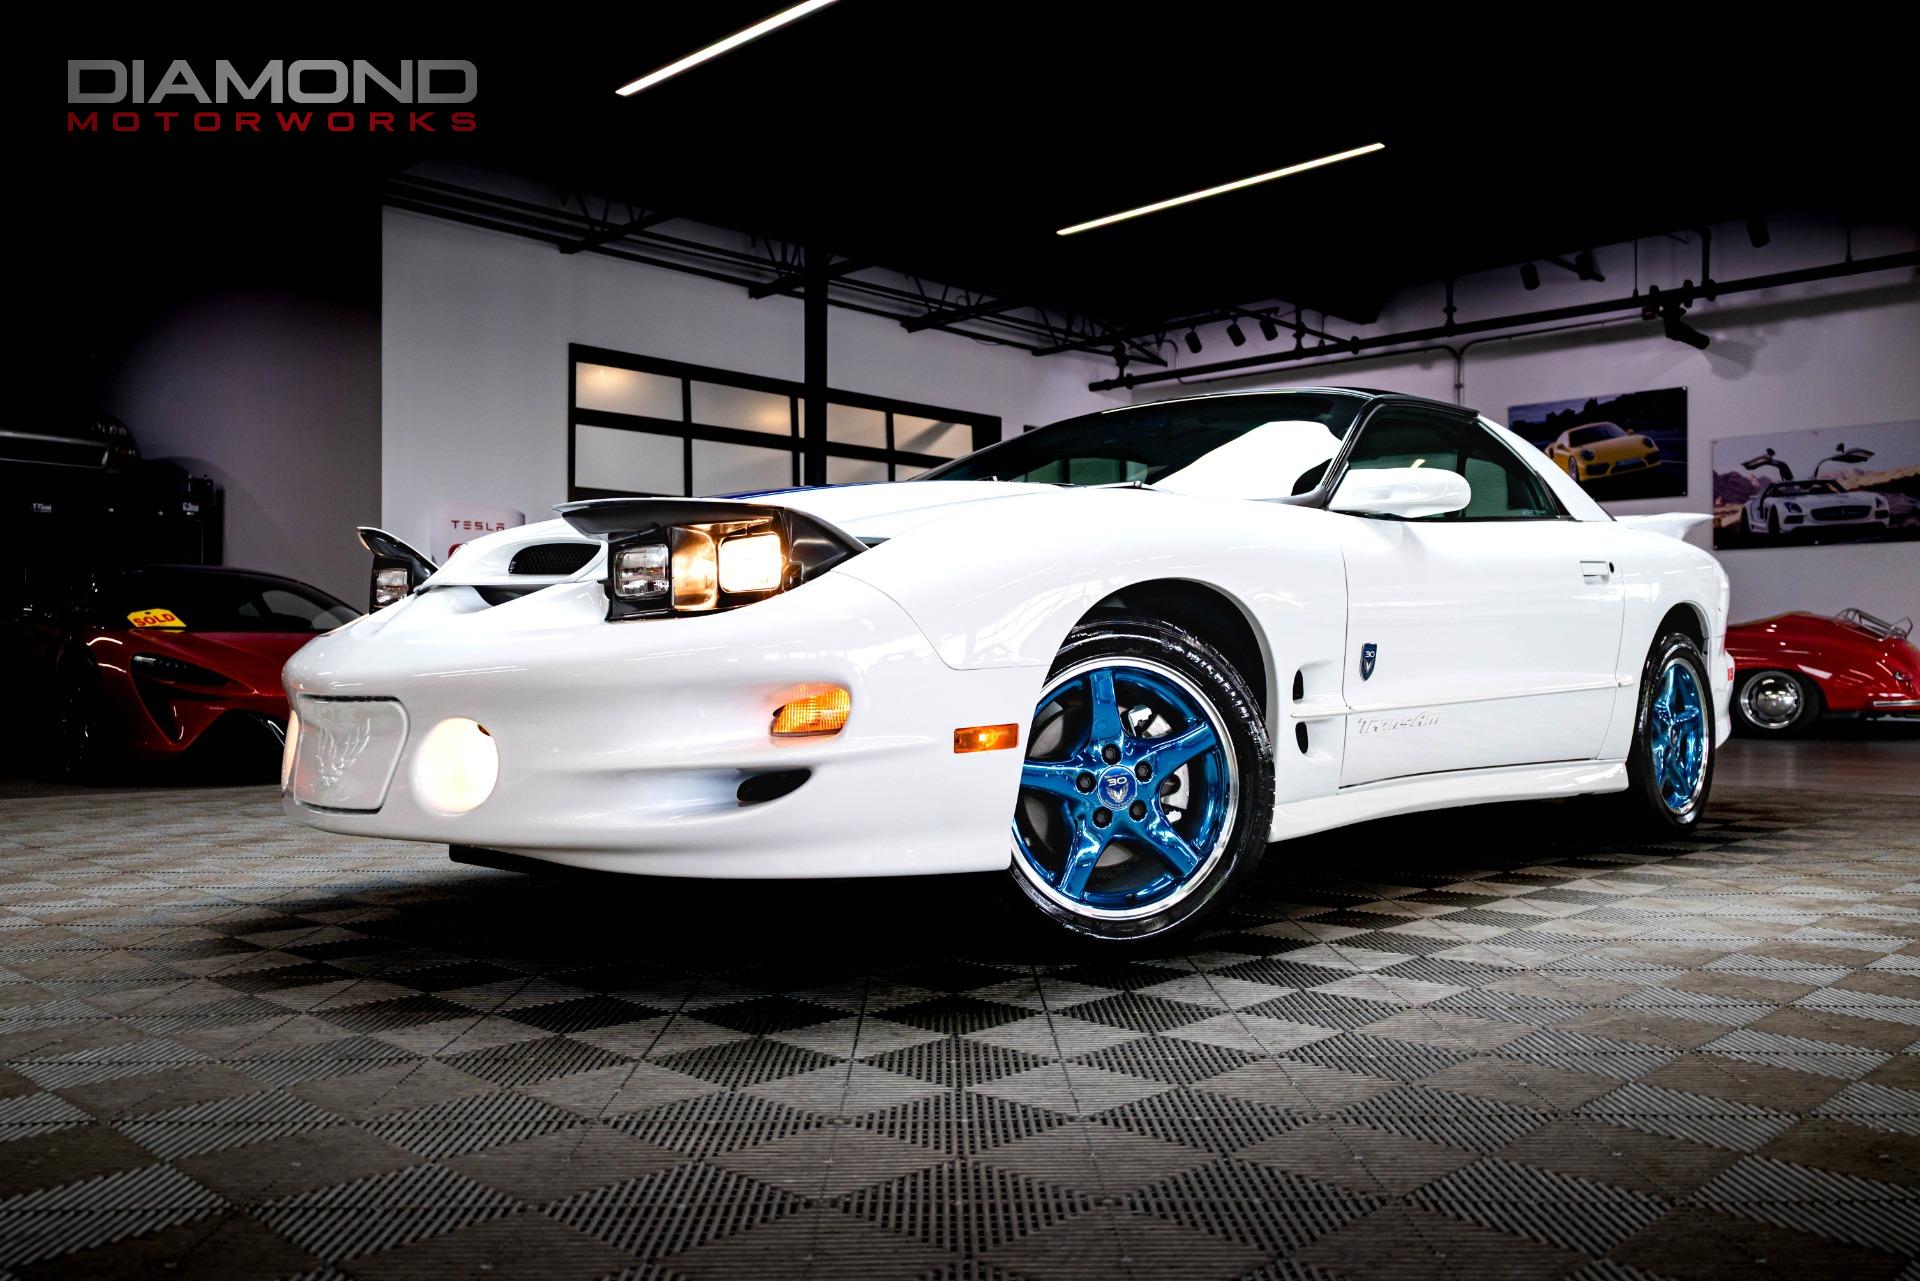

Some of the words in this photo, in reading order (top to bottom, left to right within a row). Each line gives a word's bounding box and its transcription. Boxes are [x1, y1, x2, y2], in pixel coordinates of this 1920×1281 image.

[451, 520, 505, 531] TESLA
[133, 613, 176, 627] SOLD
[1107, 776, 1128, 787] 30
